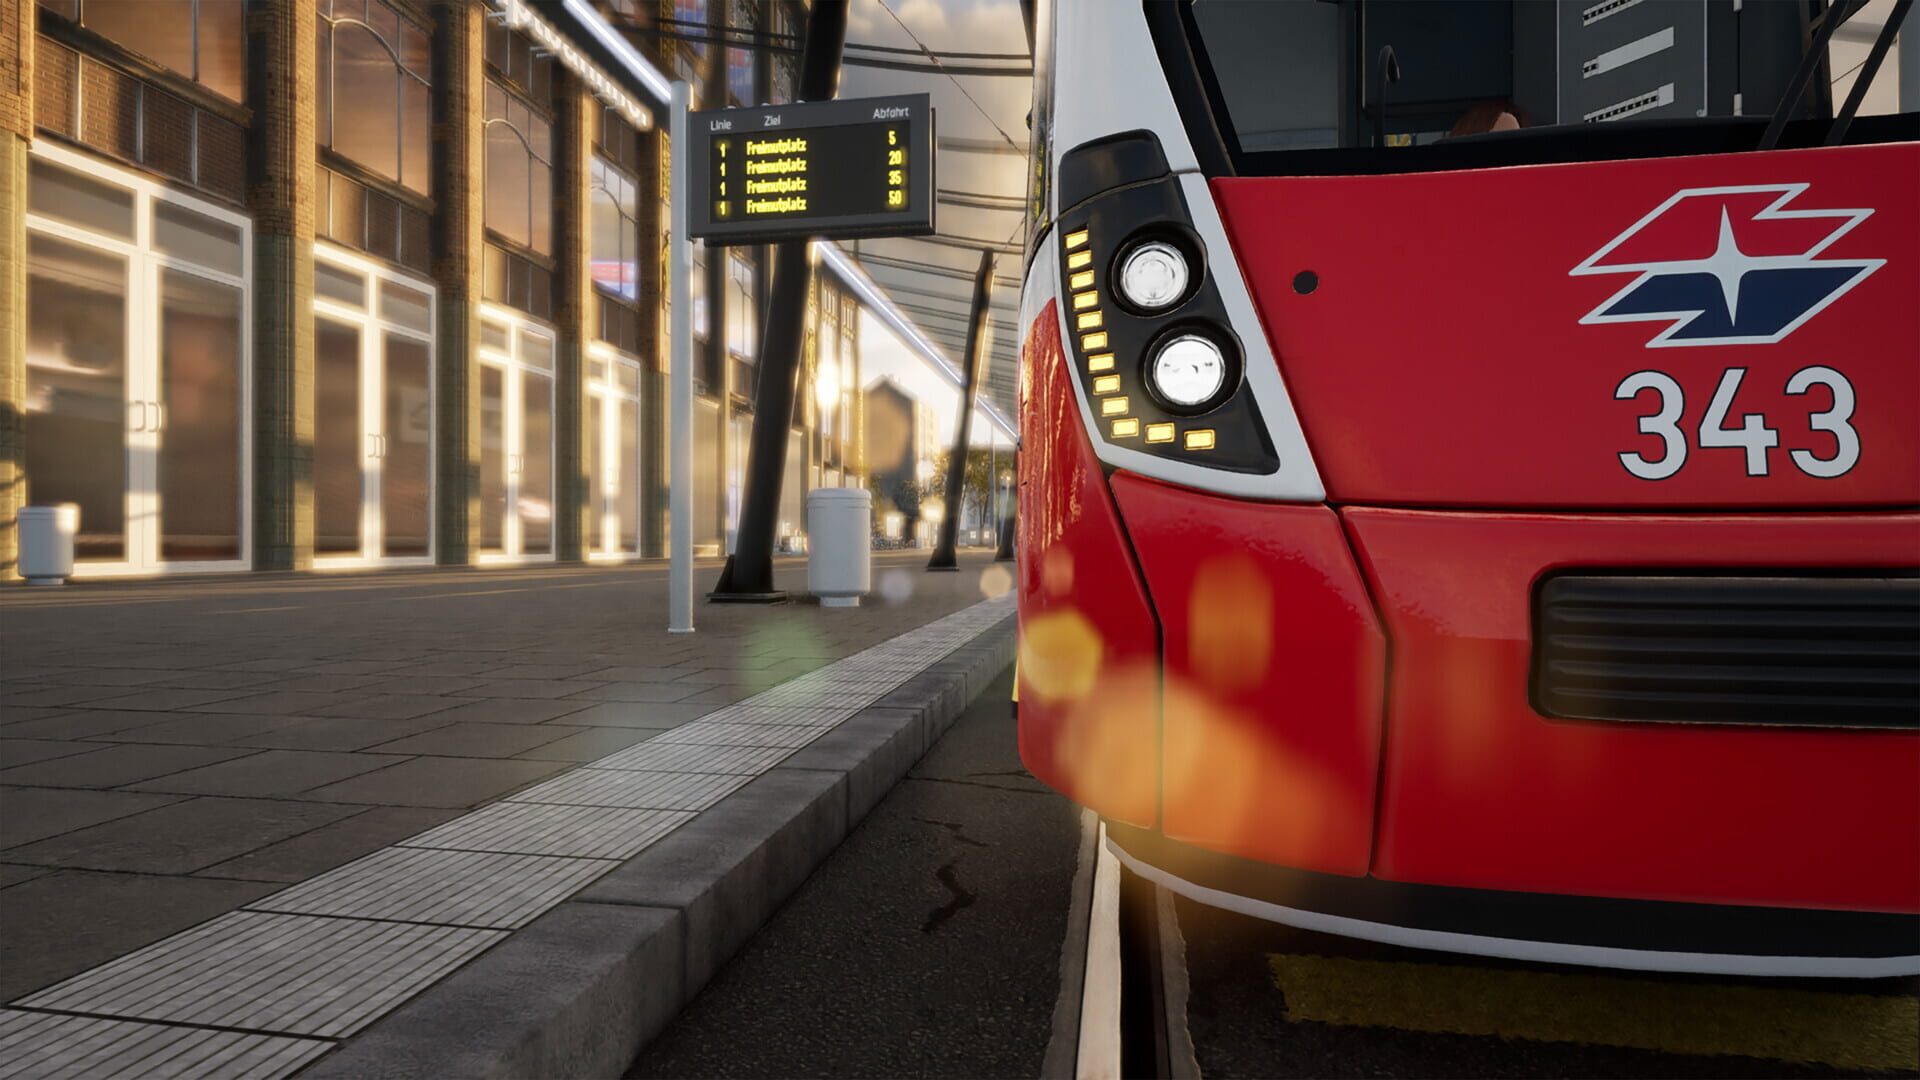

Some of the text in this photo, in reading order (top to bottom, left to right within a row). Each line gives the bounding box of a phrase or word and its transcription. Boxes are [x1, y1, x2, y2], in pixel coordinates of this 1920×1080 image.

[710, 106, 910, 131] Linie Ziel Abfahrt
[719, 131, 896, 157] 1 Freimutplatz 5
[719, 150, 902, 176] 1 Freimutplatz 20
[719, 170, 902, 196] 1 Freimutplatz 35
[719, 190, 902, 215] 1 Freimutplatz 50
[1613, 364, 1862, 481] 343
